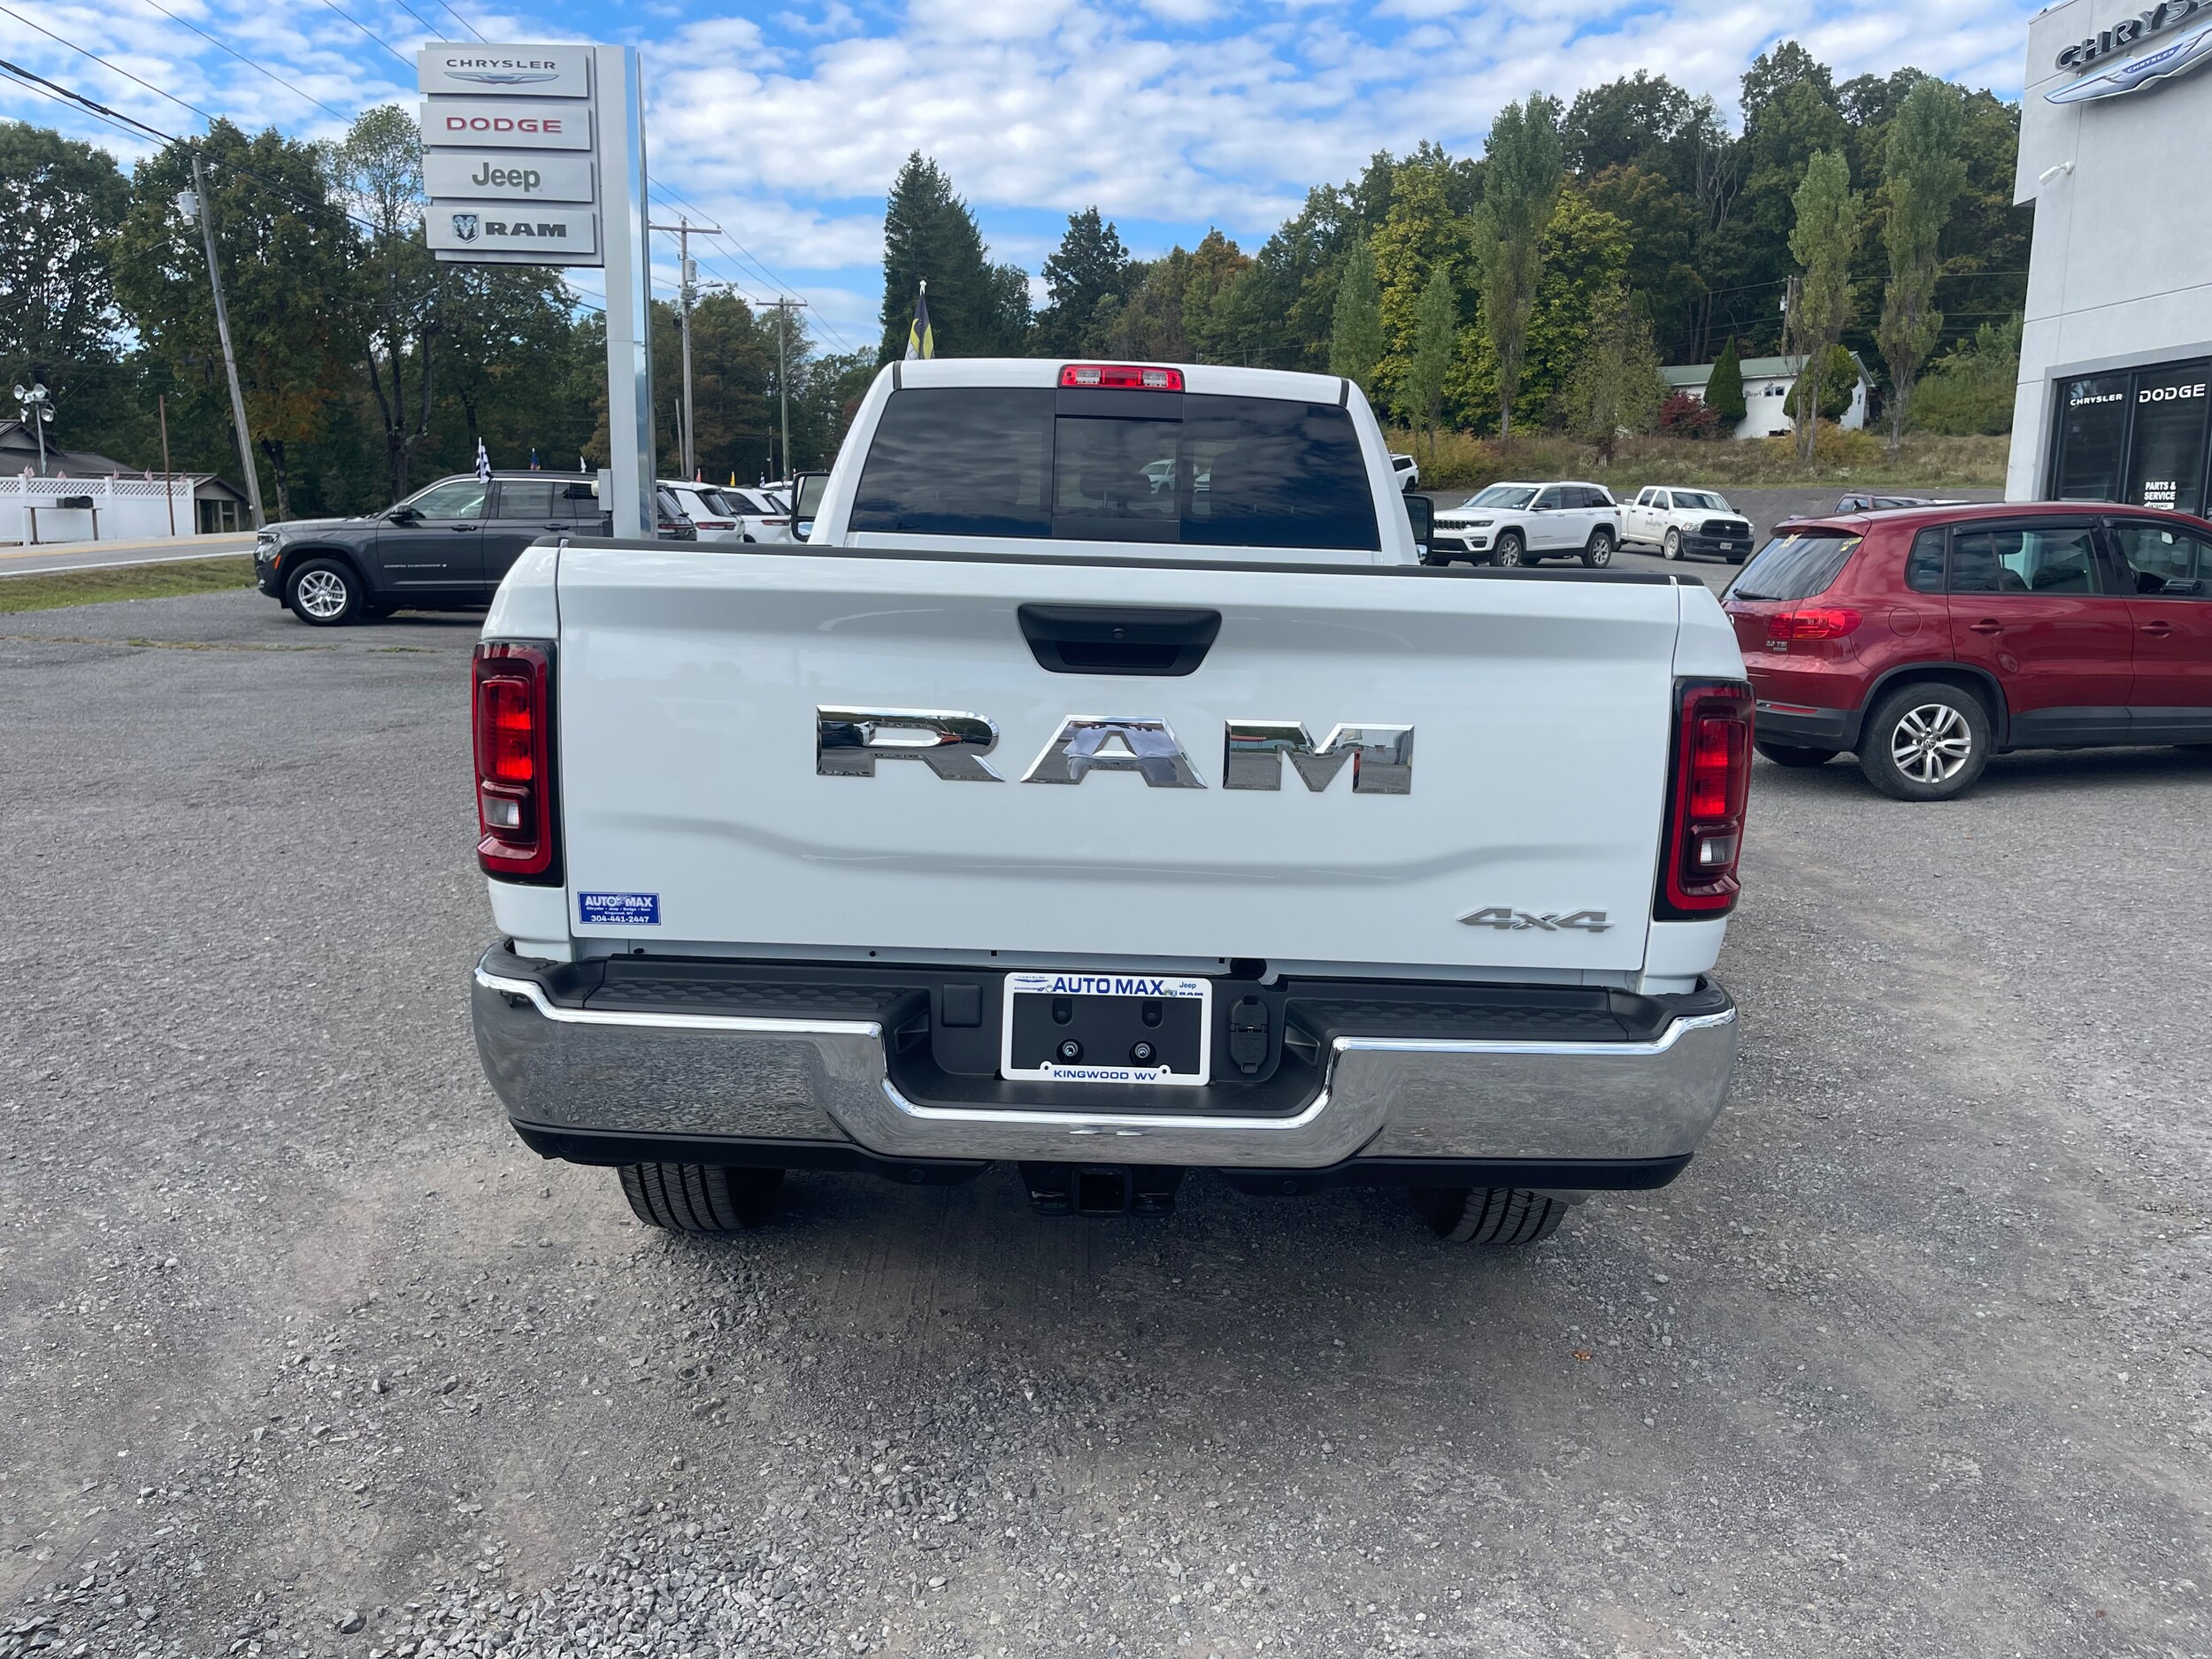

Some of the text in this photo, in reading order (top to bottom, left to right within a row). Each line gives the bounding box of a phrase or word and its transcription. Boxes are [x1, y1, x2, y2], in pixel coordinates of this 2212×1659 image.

[2055, 0, 2212, 72] CHRYS
[446, 58, 557, 70] CHRYSLER
[2127, 50, 2175, 73] CHRYSLER
[446, 117, 563, 134] DODGE
[472, 162, 541, 193] Jeep
[485, 221, 567, 238] RAM
[2070, 393, 2124, 406] CHRYSLER
[2139, 383, 2206, 403] DODGE
[2145, 481, 2177, 491] PARTS &
[2144, 491, 2176, 501] SERVICE
[816, 704, 1416, 795] RAM
[586, 895, 653, 907] AUTO MAX
[1052, 977, 1164, 995] AUTO MAX
[1054, 1070, 1129, 1079] KINGWOOD
